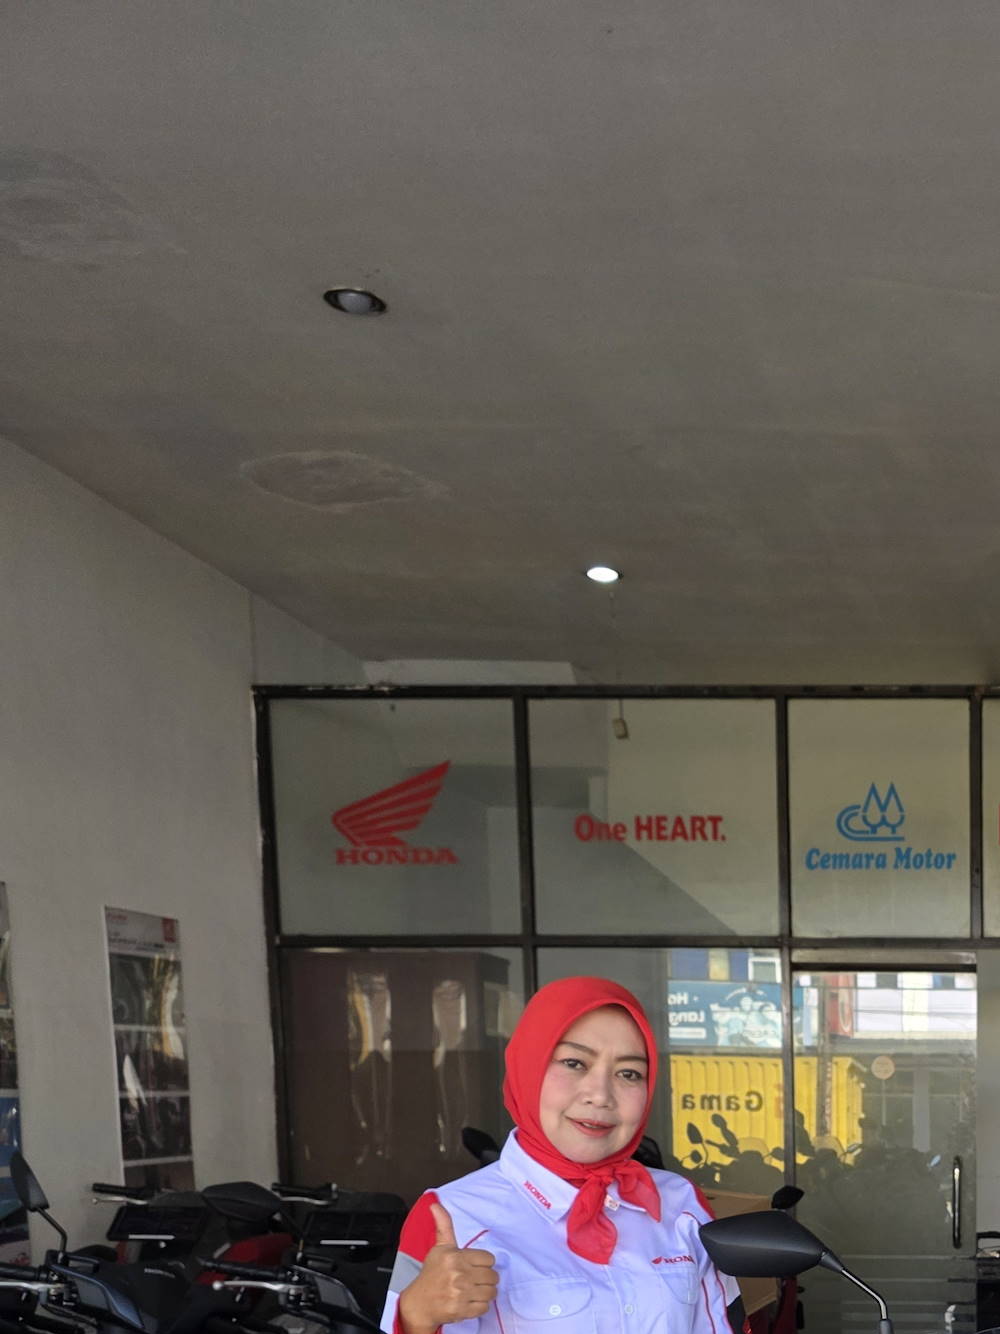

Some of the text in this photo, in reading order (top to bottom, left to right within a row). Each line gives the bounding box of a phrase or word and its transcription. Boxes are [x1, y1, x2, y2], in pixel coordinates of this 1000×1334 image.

[574, 814, 726, 842] One HEART.
[335, 847, 459, 866] HONDA
[805, 847, 957, 870] Cemara Motor
[523, 1180, 552, 1209] HONDA
